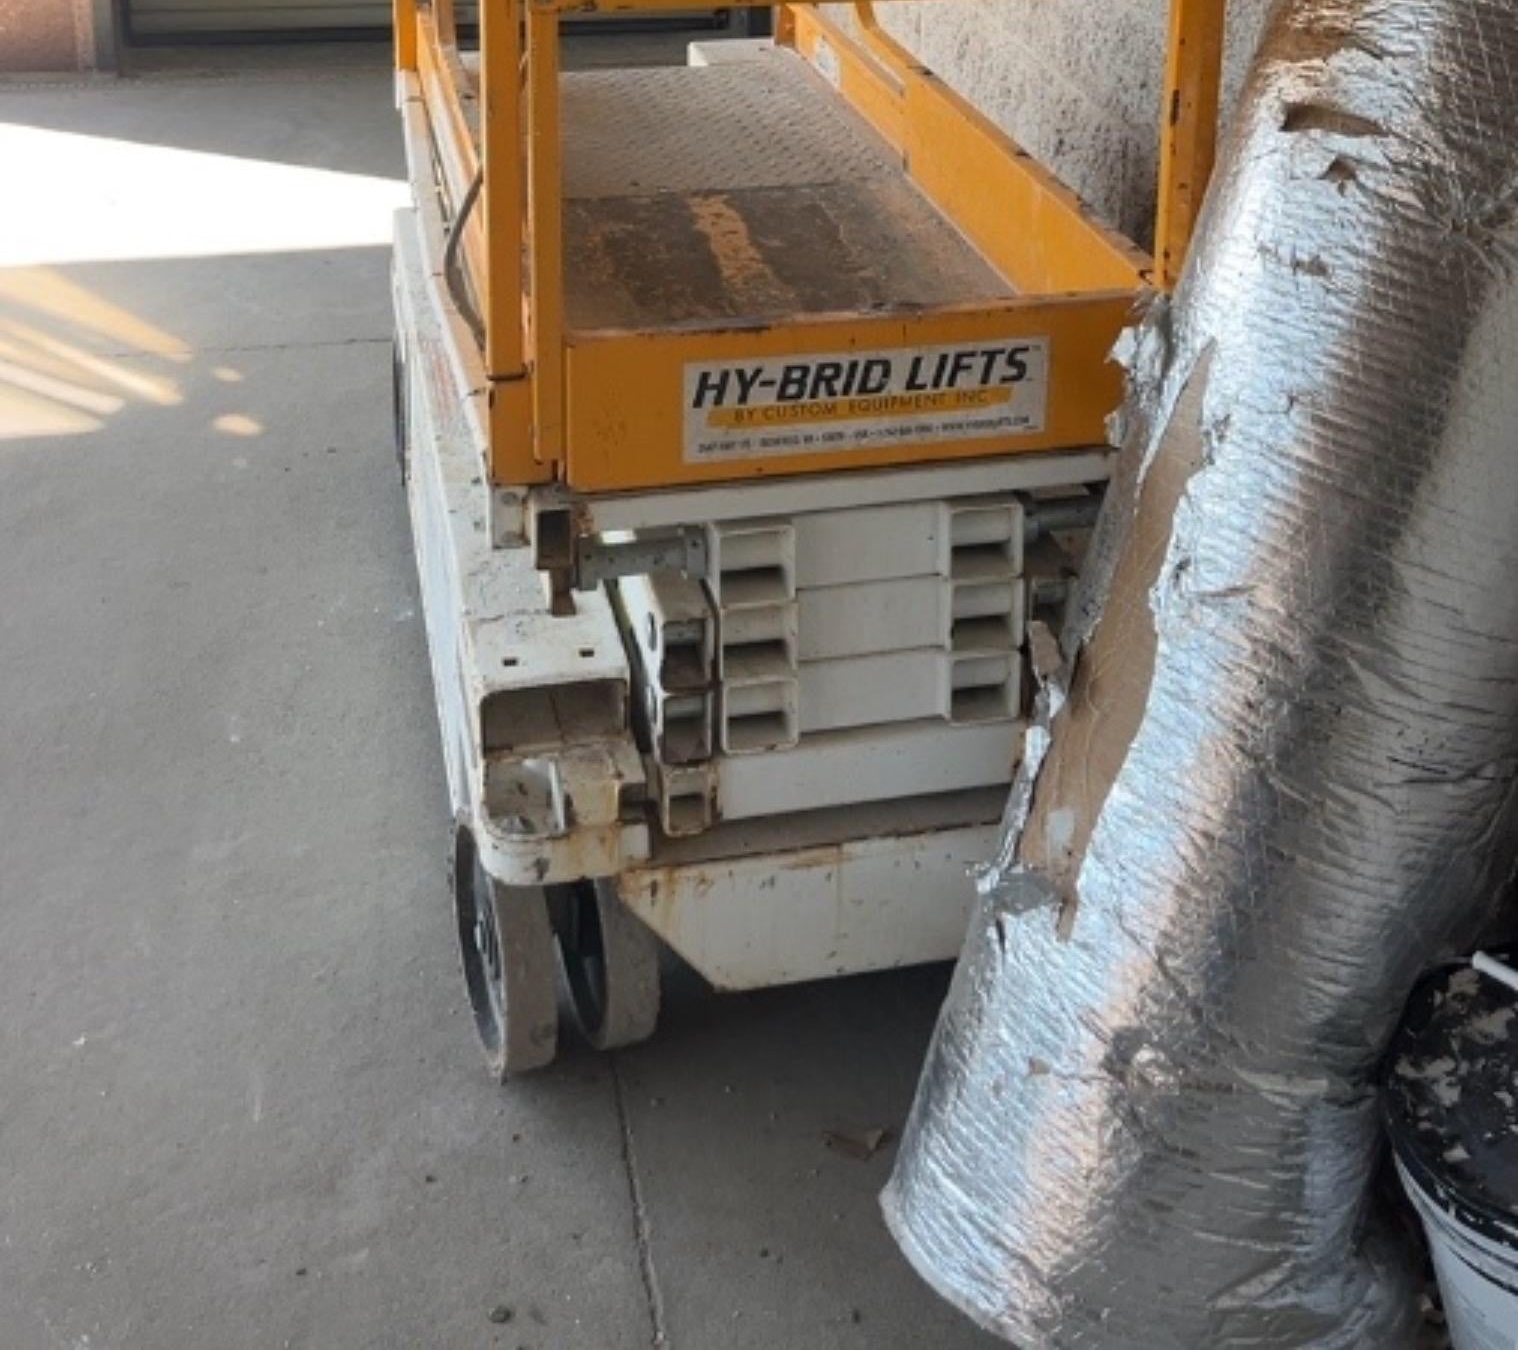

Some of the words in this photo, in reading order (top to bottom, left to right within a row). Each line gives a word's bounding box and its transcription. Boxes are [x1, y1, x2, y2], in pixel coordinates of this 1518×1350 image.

[693, 358, 890, 409] HY-BRID
[904, 346, 1031, 391] LIFTS
[734, 406, 757, 423] BY
[763, 401, 838, 421] CUSTOM
[849, 393, 946, 415] EQUIPMENT
